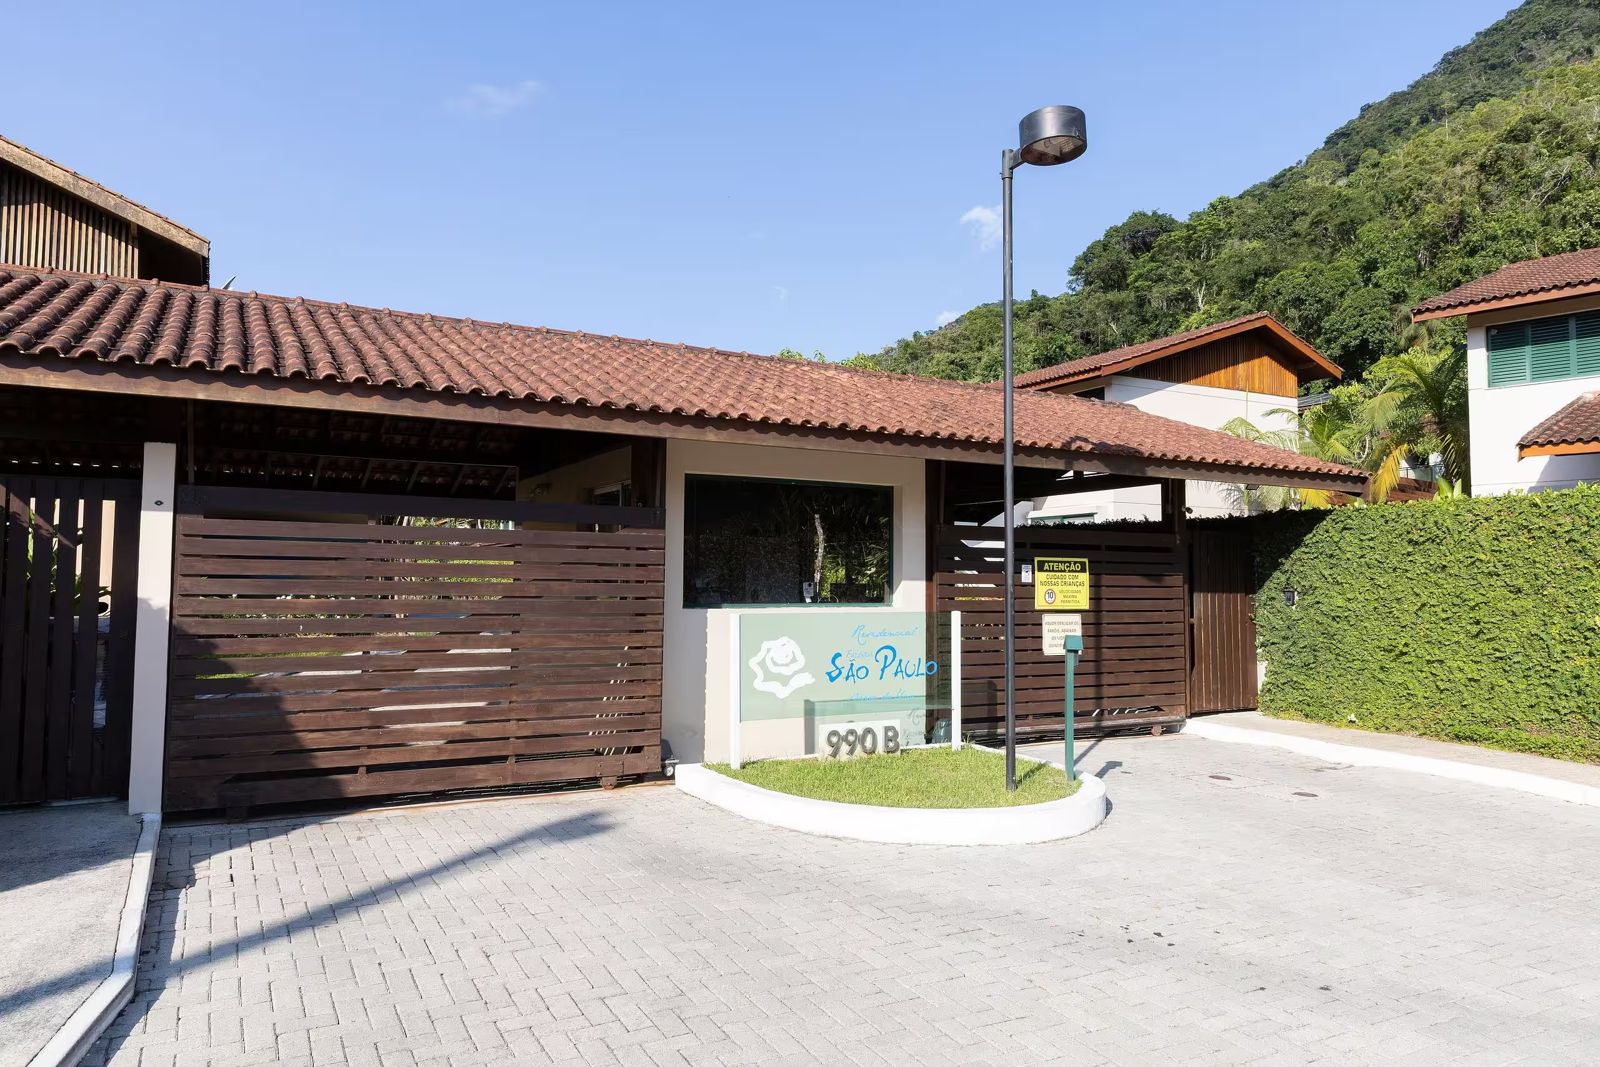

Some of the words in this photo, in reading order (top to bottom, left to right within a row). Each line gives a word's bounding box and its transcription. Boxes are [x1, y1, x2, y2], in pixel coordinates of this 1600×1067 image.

[1044, 562, 1081, 572] ATENÇÃO
[1047, 591, 1054, 599] 10
[825, 652, 869, 684] SÃO
[875, 645, 938, 681] PAULO
[826, 727, 878, 758] 990
[884, 725, 900, 754] B
